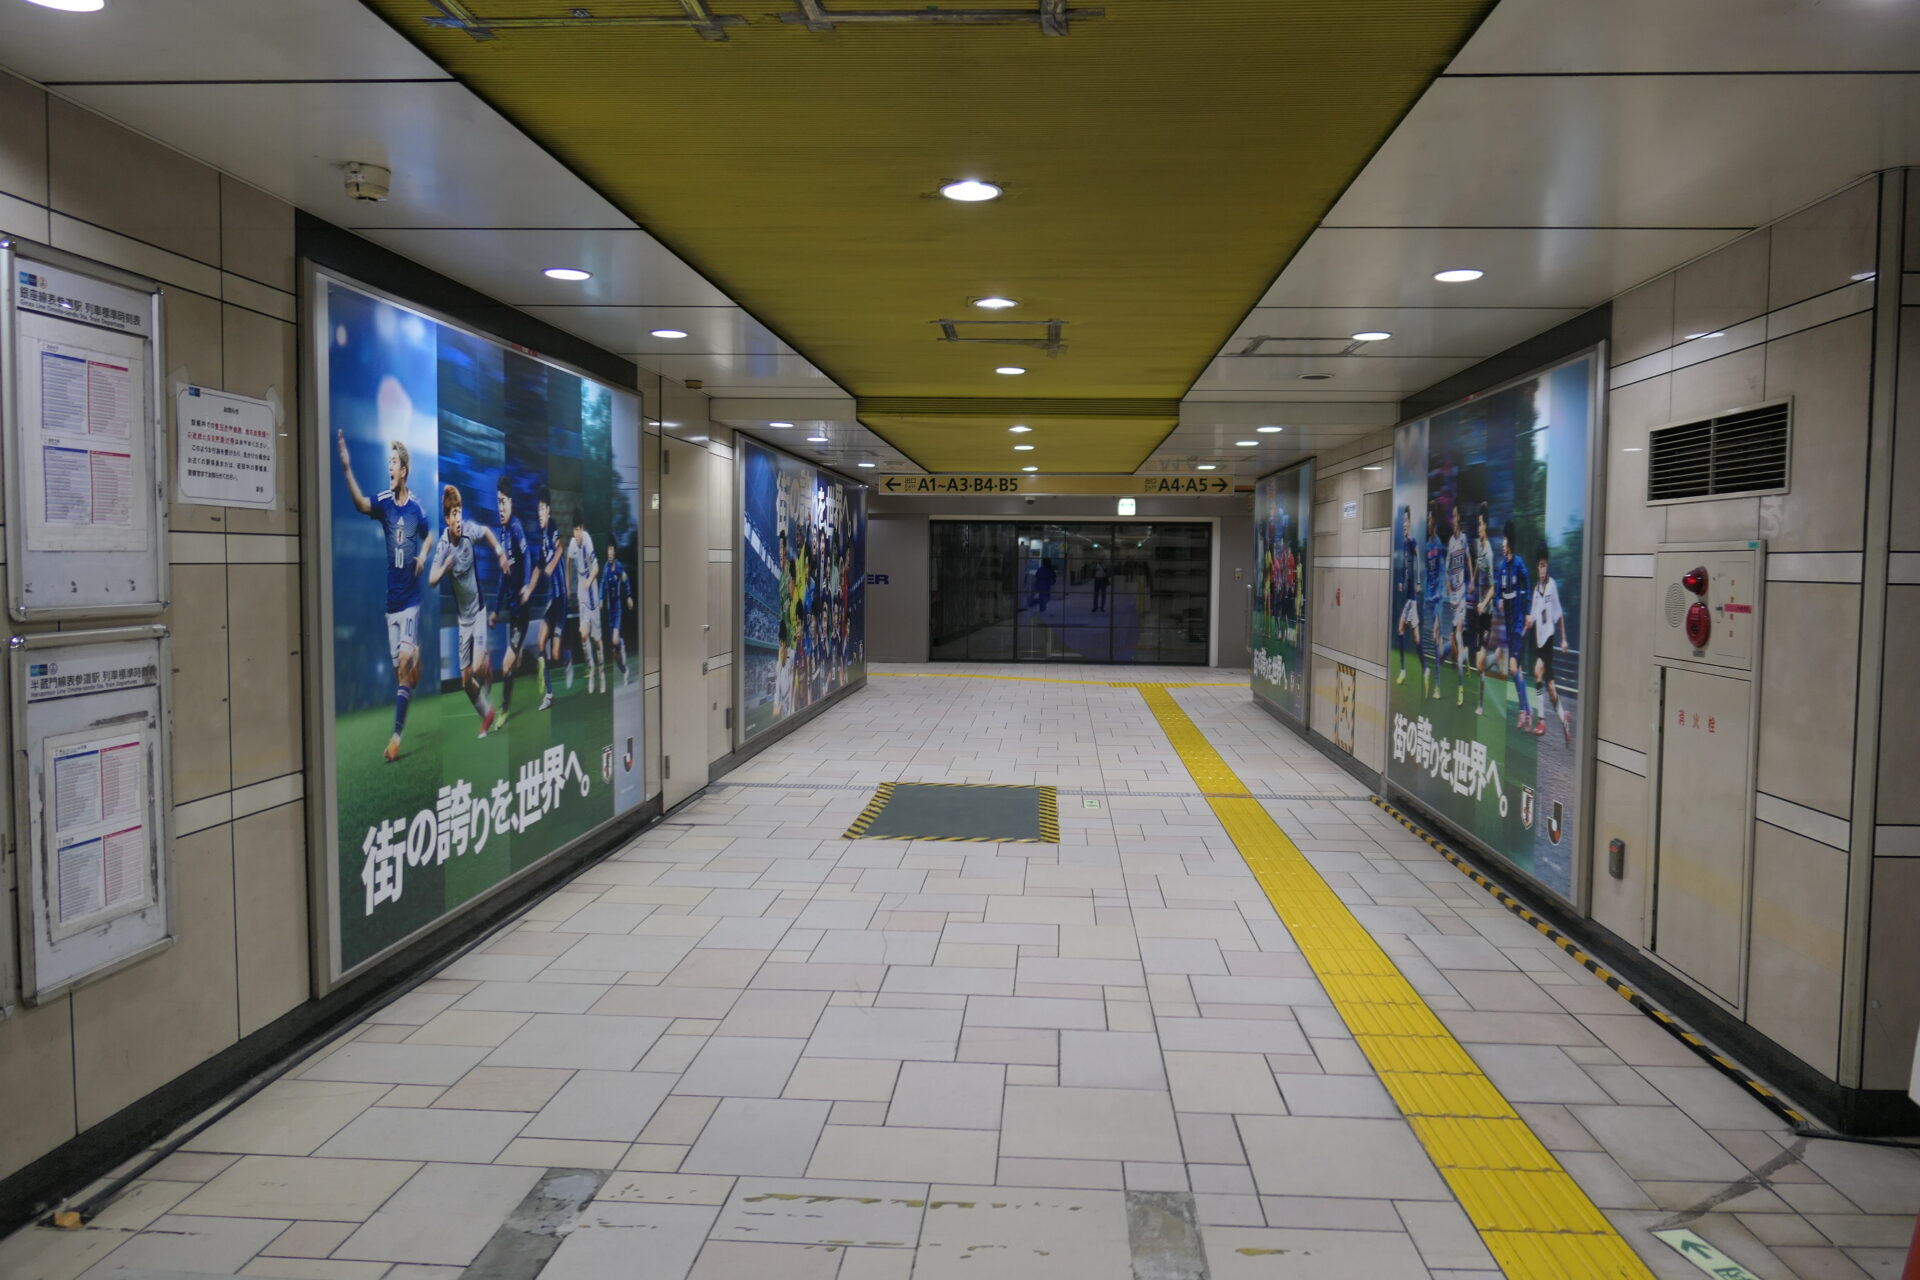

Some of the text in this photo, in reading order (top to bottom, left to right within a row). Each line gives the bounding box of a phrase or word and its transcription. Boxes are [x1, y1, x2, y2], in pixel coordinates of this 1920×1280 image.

[361, 743, 591, 917] 街の誇りを、世界へ。
[1393, 712, 1509, 818] 街の誇りを、世界へ。
